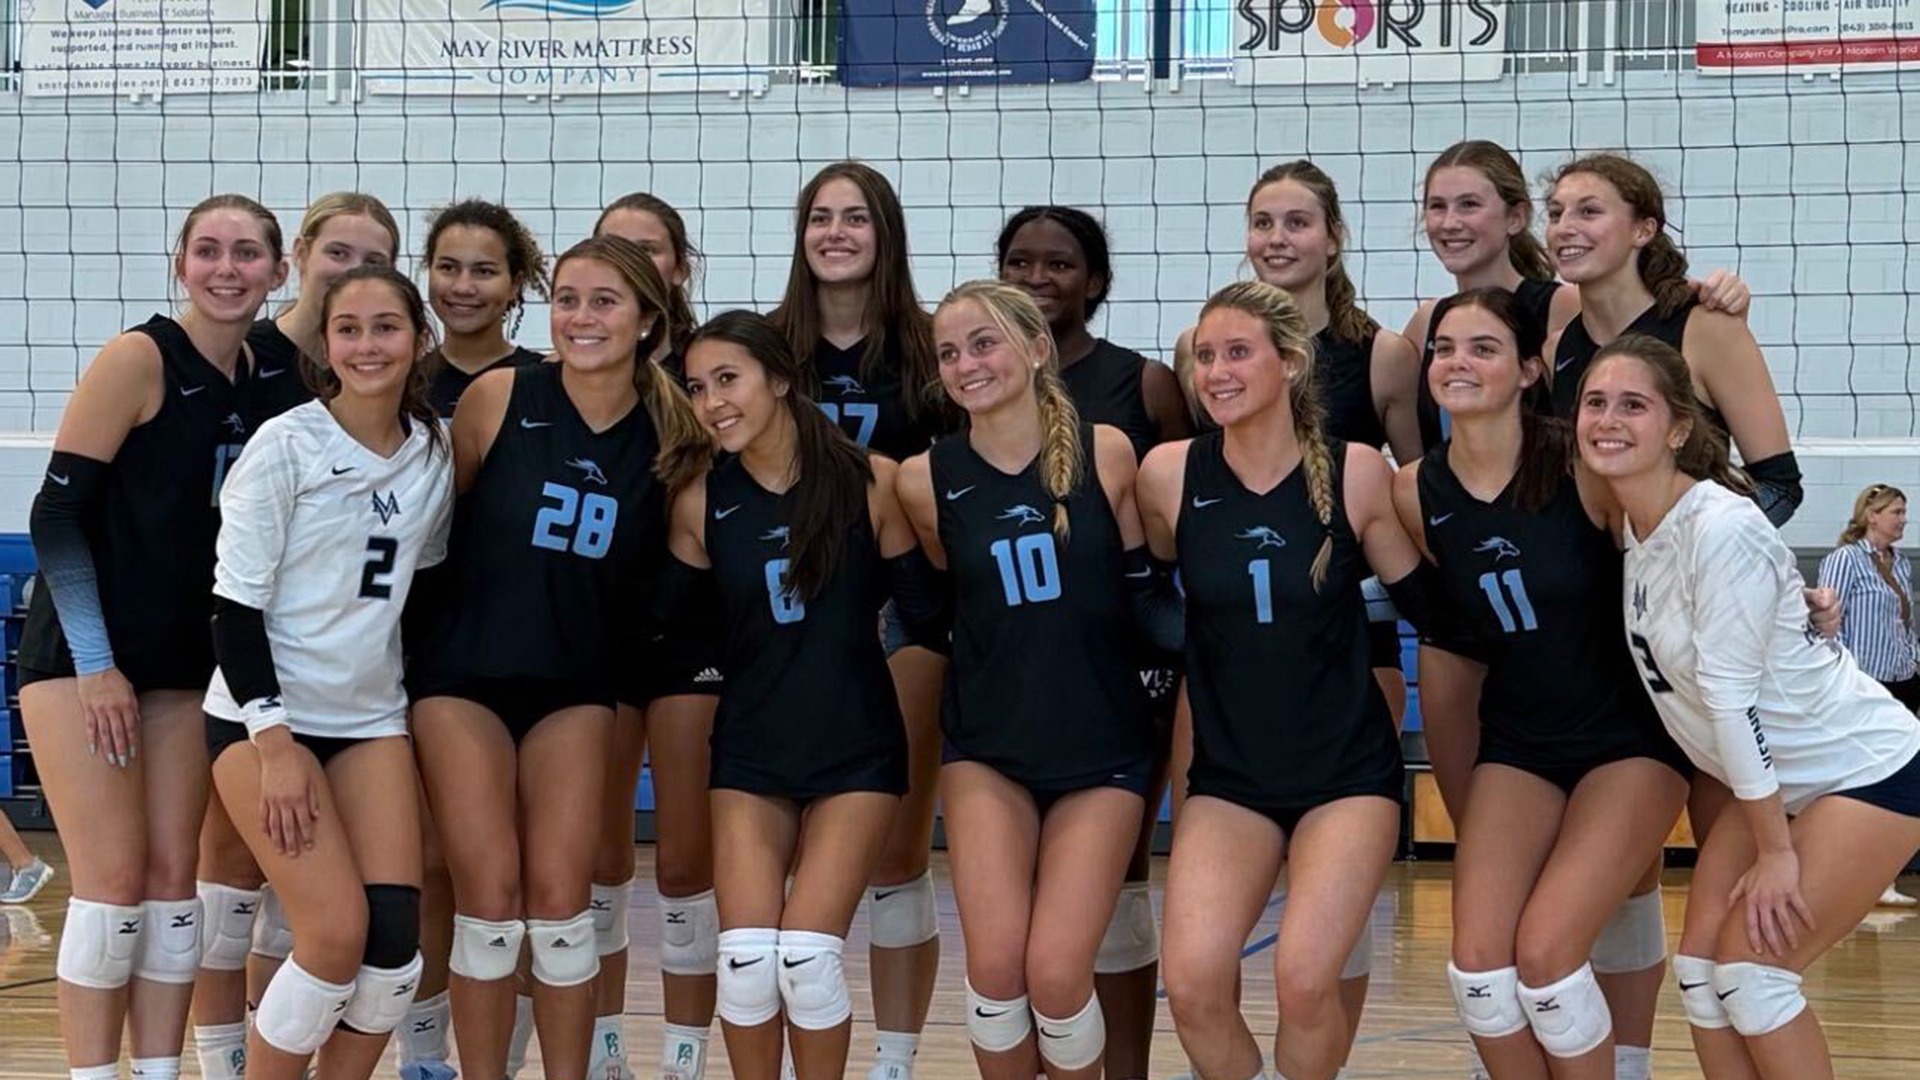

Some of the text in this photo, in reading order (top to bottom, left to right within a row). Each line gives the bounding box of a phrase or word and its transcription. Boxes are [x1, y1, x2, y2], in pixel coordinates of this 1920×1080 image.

[1726, 0, 1910, 13] HEATING COOLING AIR QUALTY
[51, 30, 67, 38] We
[69, 29, 96, 39] keep
[441, 36, 693, 59] MAY RIVER MATTRESS
[1716, 51, 1725, 59] A
[1818, 47, 1834, 55] For
[1846, 46, 1886, 54] Modern
[487, 67, 639, 85] COMPANY
[531, 481, 618, 560] 28
[358, 536, 398, 601] 2
[990, 532, 1061, 606] 10
[1248, 559, 1273, 623] 1
[1479, 568, 1538, 632] 11
